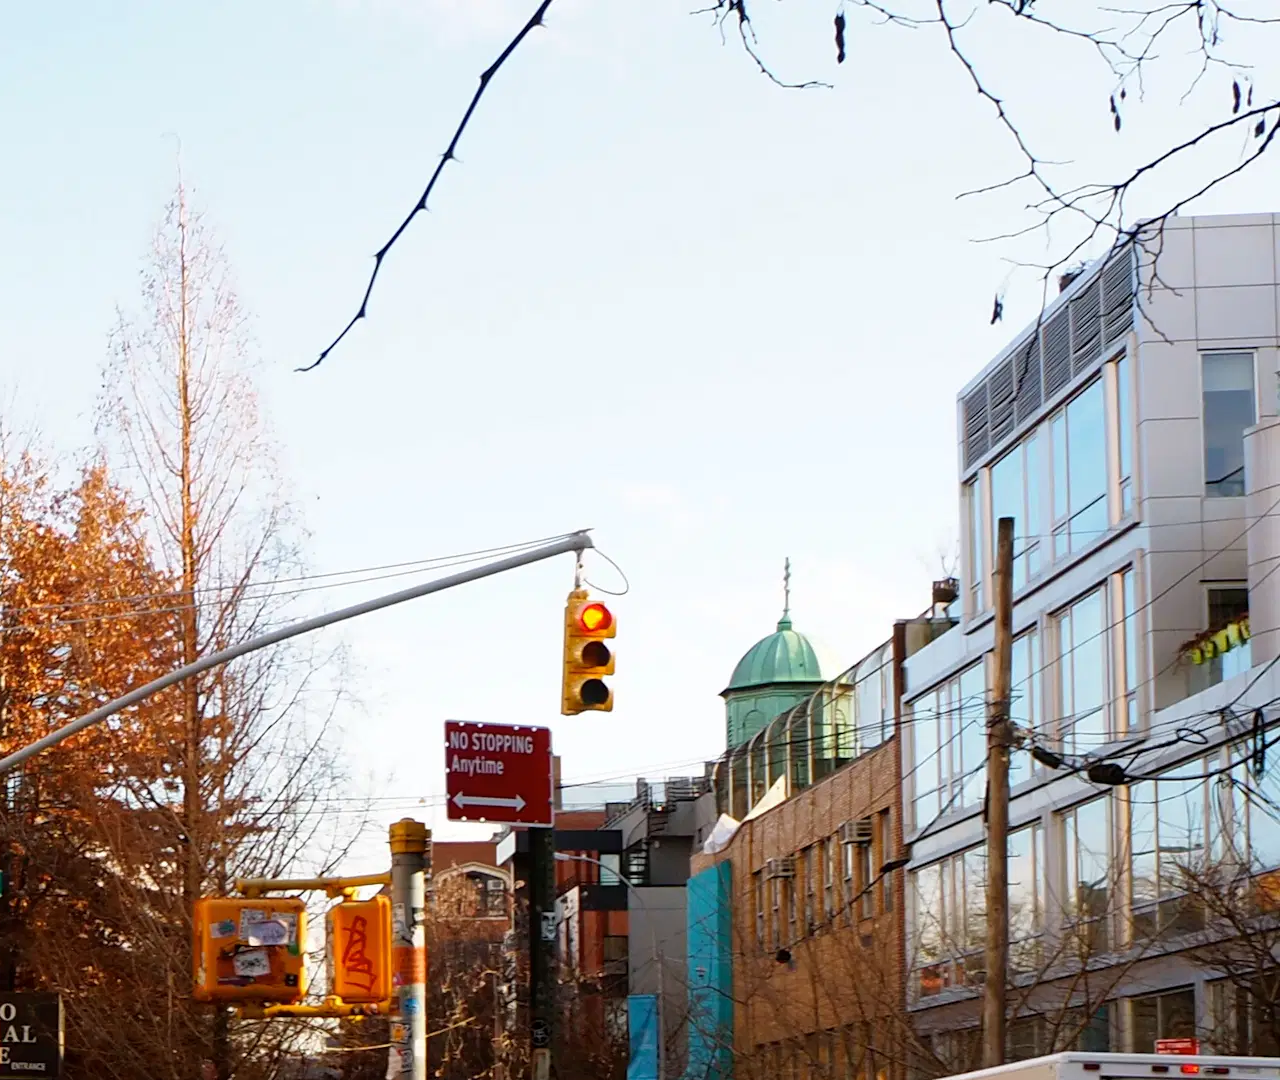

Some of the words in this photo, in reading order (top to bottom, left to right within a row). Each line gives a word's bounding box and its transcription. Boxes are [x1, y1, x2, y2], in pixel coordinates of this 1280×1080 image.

[450, 731, 469, 749] NO
[472, 732, 534, 754] STOPPING
[451, 754, 505, 777] Anytime
